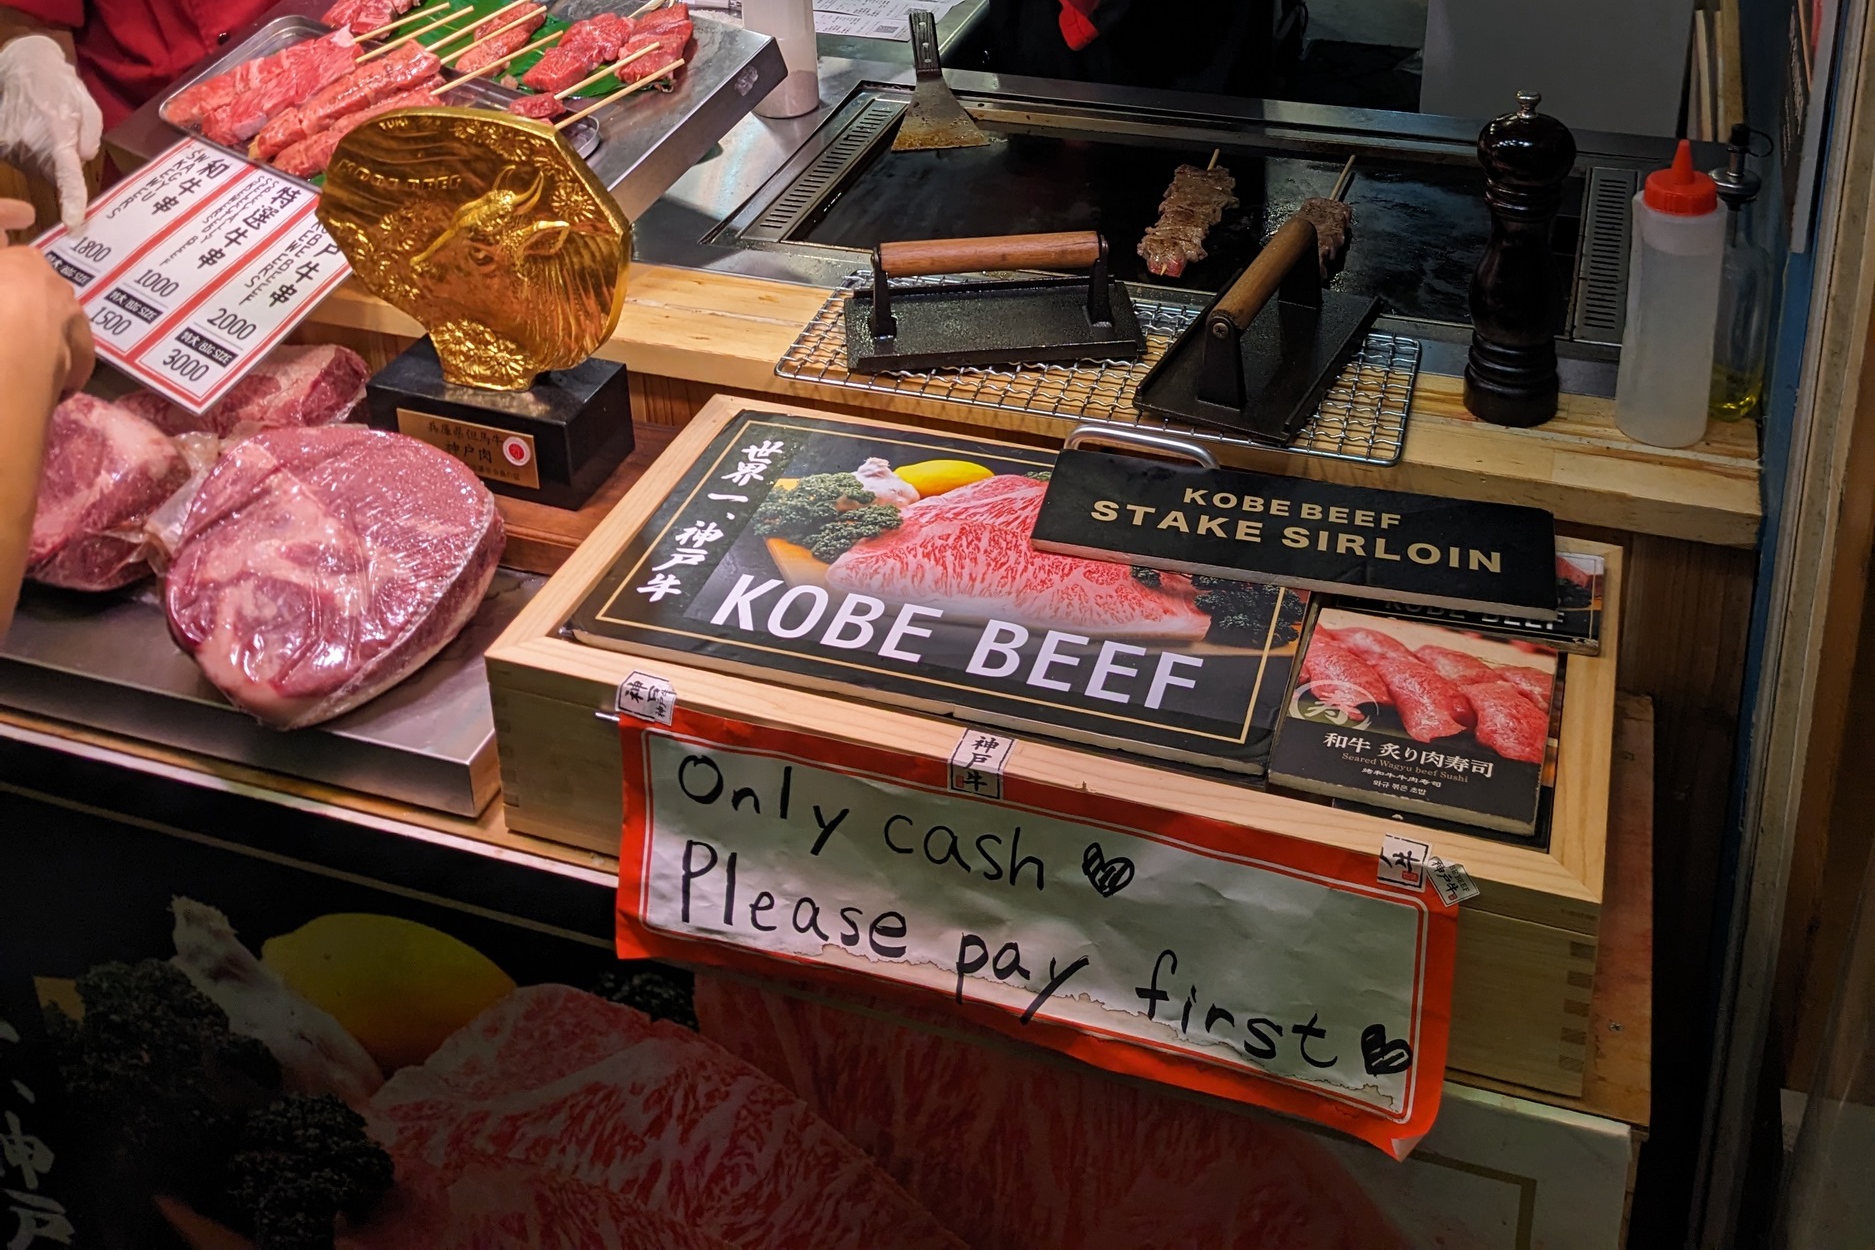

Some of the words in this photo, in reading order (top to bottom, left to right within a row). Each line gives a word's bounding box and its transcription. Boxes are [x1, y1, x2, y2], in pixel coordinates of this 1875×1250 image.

[106, 150, 201, 220] SKEWERS
[141, 152, 210, 202] WAGYU
[151, 158, 231, 215] 和牛串
[70, 236, 111, 262] 1800
[197, 186, 301, 269] 特選牛串
[134, 269, 179, 297] 1000
[268, 243, 340, 308] 戸牛串
[90, 306, 132, 335] 1500
[206, 307, 257, 341] 2000
[162, 348, 210, 382] 3000
[1183, 487, 1290, 518] KOBE
[1299, 502, 1401, 529] BEEF
[1090, 501, 1264, 544] STAKE
[1281, 526, 1502, 574] SIRLOIN
[710, 574, 944, 663] KOBE
[965, 618, 1203, 711] BEEF
[961, 735, 999, 792] 神戸牛
[1323, 732, 1371, 753] 和牛
[1377, 742, 1494, 778] 炙り肉寿司
[1342, 752, 1377, 765] Seared
[1379, 759, 1413, 772] Wagyu
[1415, 766, 1438, 777] beef
[1440, 771, 1469, 784] Sushi
[678, 754, 849, 856] Only
[884, 814, 1045, 890] cash
[682, 840, 908, 958] Please
[957, 932, 1090, 1025] pay
[1135, 949, 1339, 1069] first
